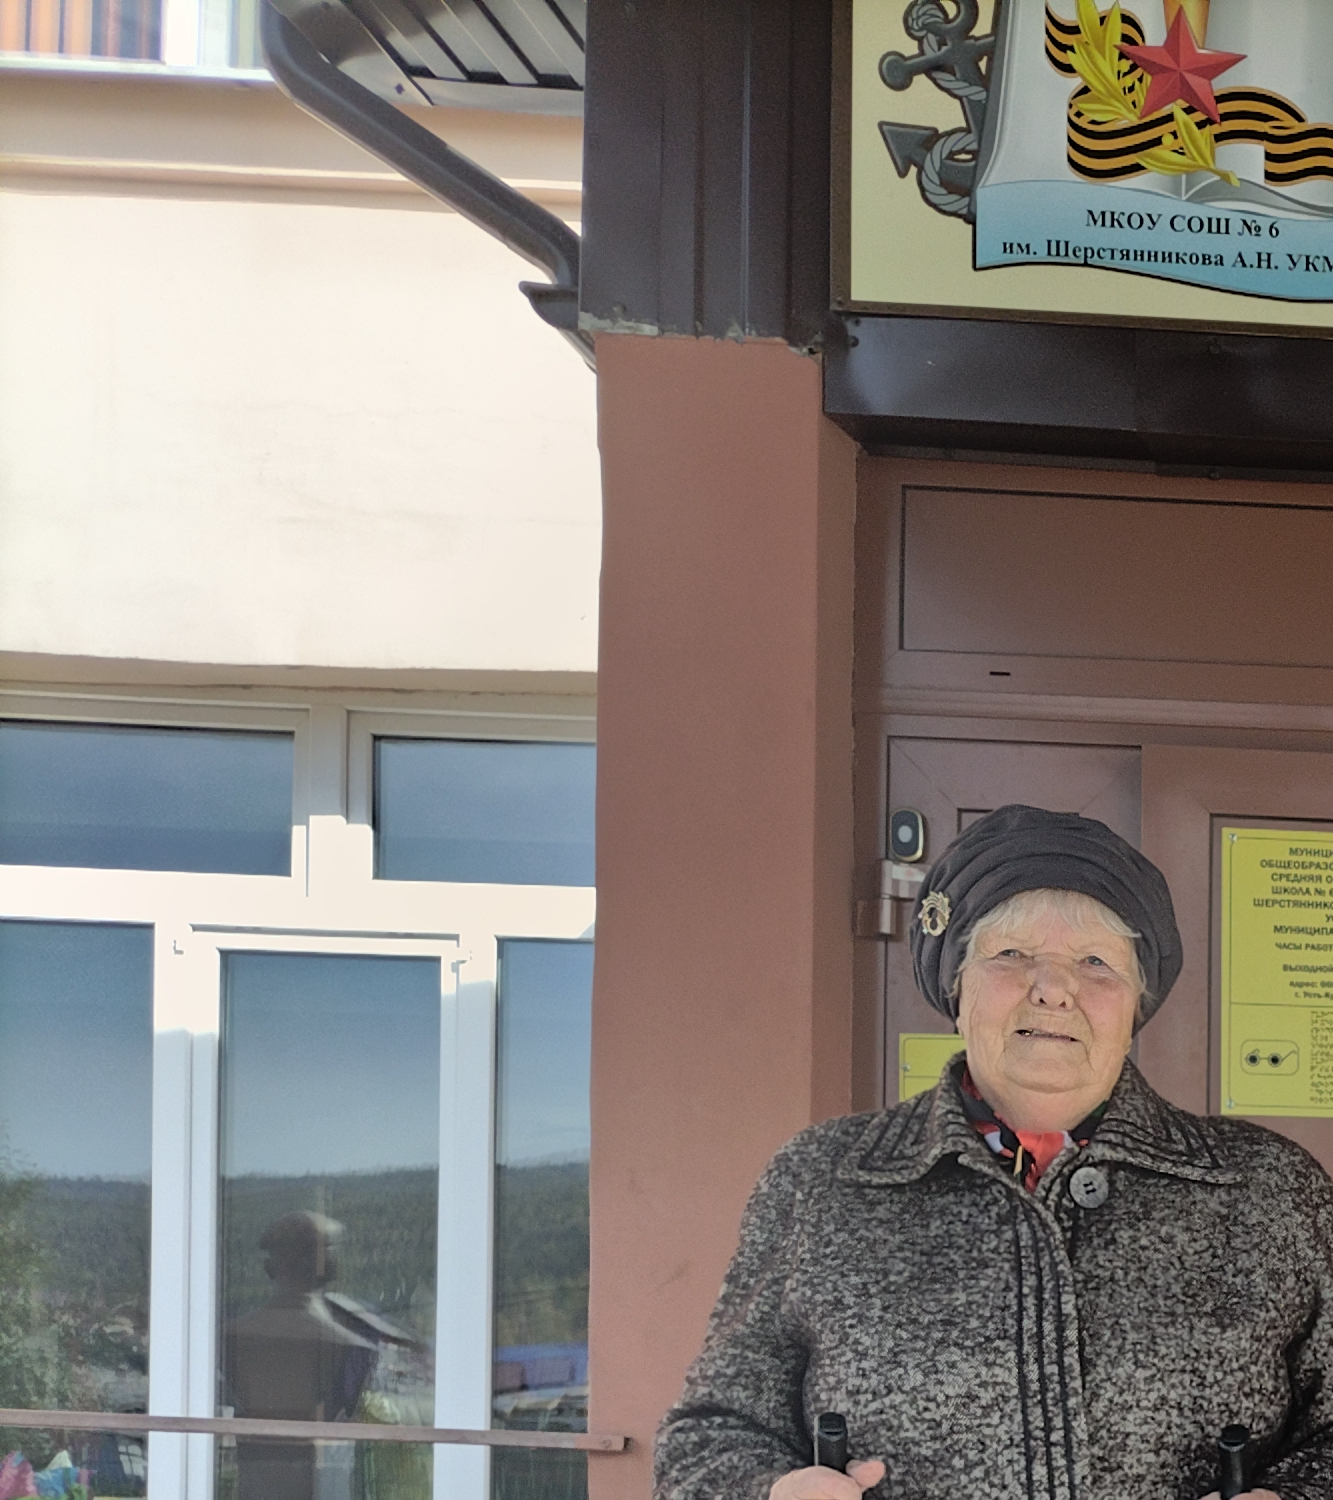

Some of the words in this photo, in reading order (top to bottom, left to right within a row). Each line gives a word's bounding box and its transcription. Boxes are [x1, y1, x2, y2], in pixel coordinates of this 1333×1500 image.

[1086, 209, 1163, 231] МКОУ
[1169, 214, 1230, 235] СОШ
[1237, 218, 1262, 237] №
[1268, 220, 1280, 238] 6
[1002, 241, 1037, 256] им.
[1046, 239, 1225, 267] Шерстянникова
[1231, 251, 1279, 270] А.Н.
[1270, 872, 1323, 885] СРЕДНЯЯ
[1271, 885, 1312, 897] ШКОЛА
[1314, 887, 1326, 897] №
